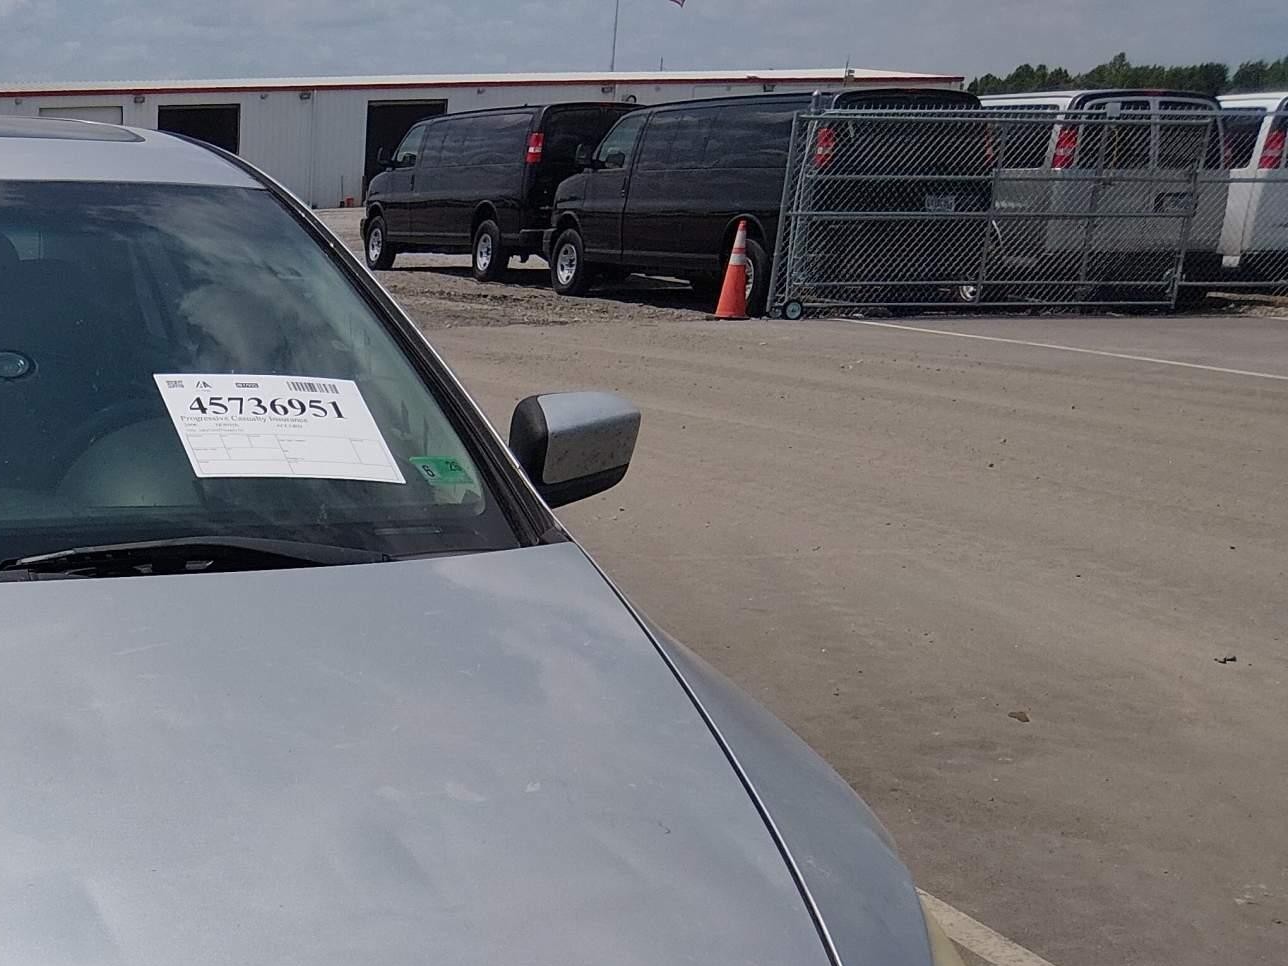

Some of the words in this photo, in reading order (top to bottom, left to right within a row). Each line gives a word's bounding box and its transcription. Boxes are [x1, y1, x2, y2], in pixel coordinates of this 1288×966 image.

[189, 396, 346, 419] 45736951
[180, 415, 229, 423] Progressive
[230, 415, 267, 424] Casualty
